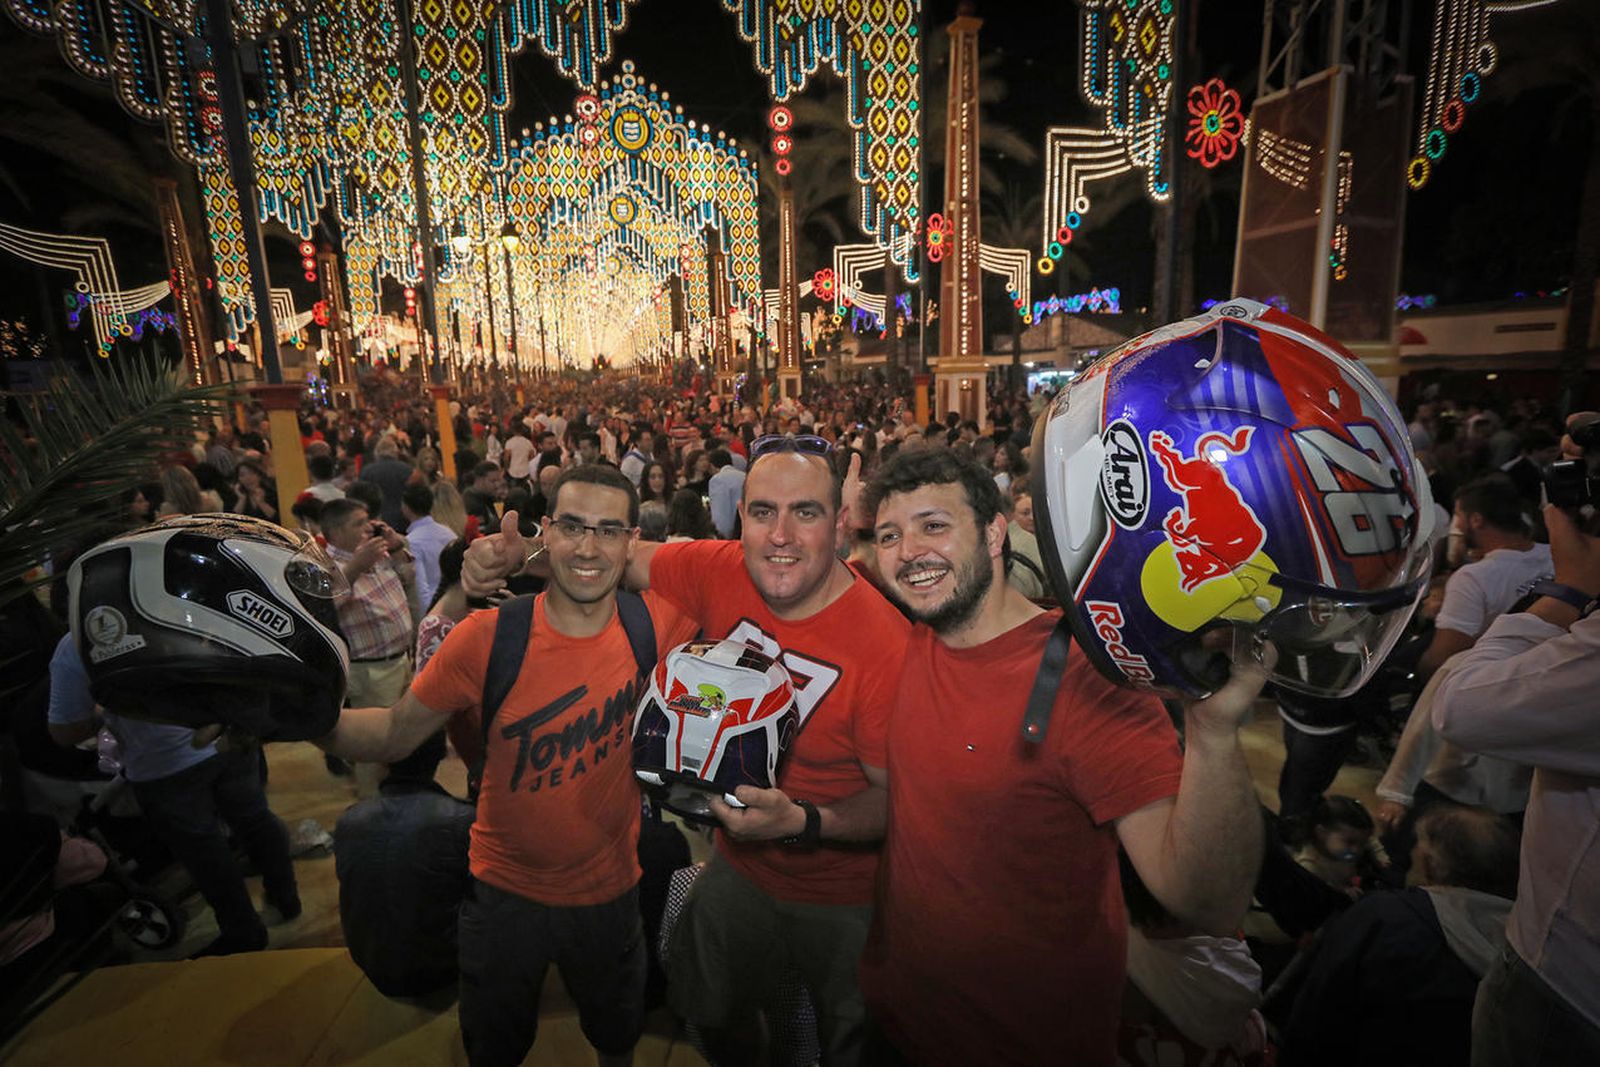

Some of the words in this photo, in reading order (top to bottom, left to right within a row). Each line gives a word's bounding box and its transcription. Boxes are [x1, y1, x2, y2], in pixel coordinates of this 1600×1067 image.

[1109, 431, 1144, 514] Arai
[1291, 424, 1415, 555] 26
[236, 596, 288, 633] SHOEI
[501, 672, 640, 793] Tomm
[529, 727, 625, 793] JEANS
